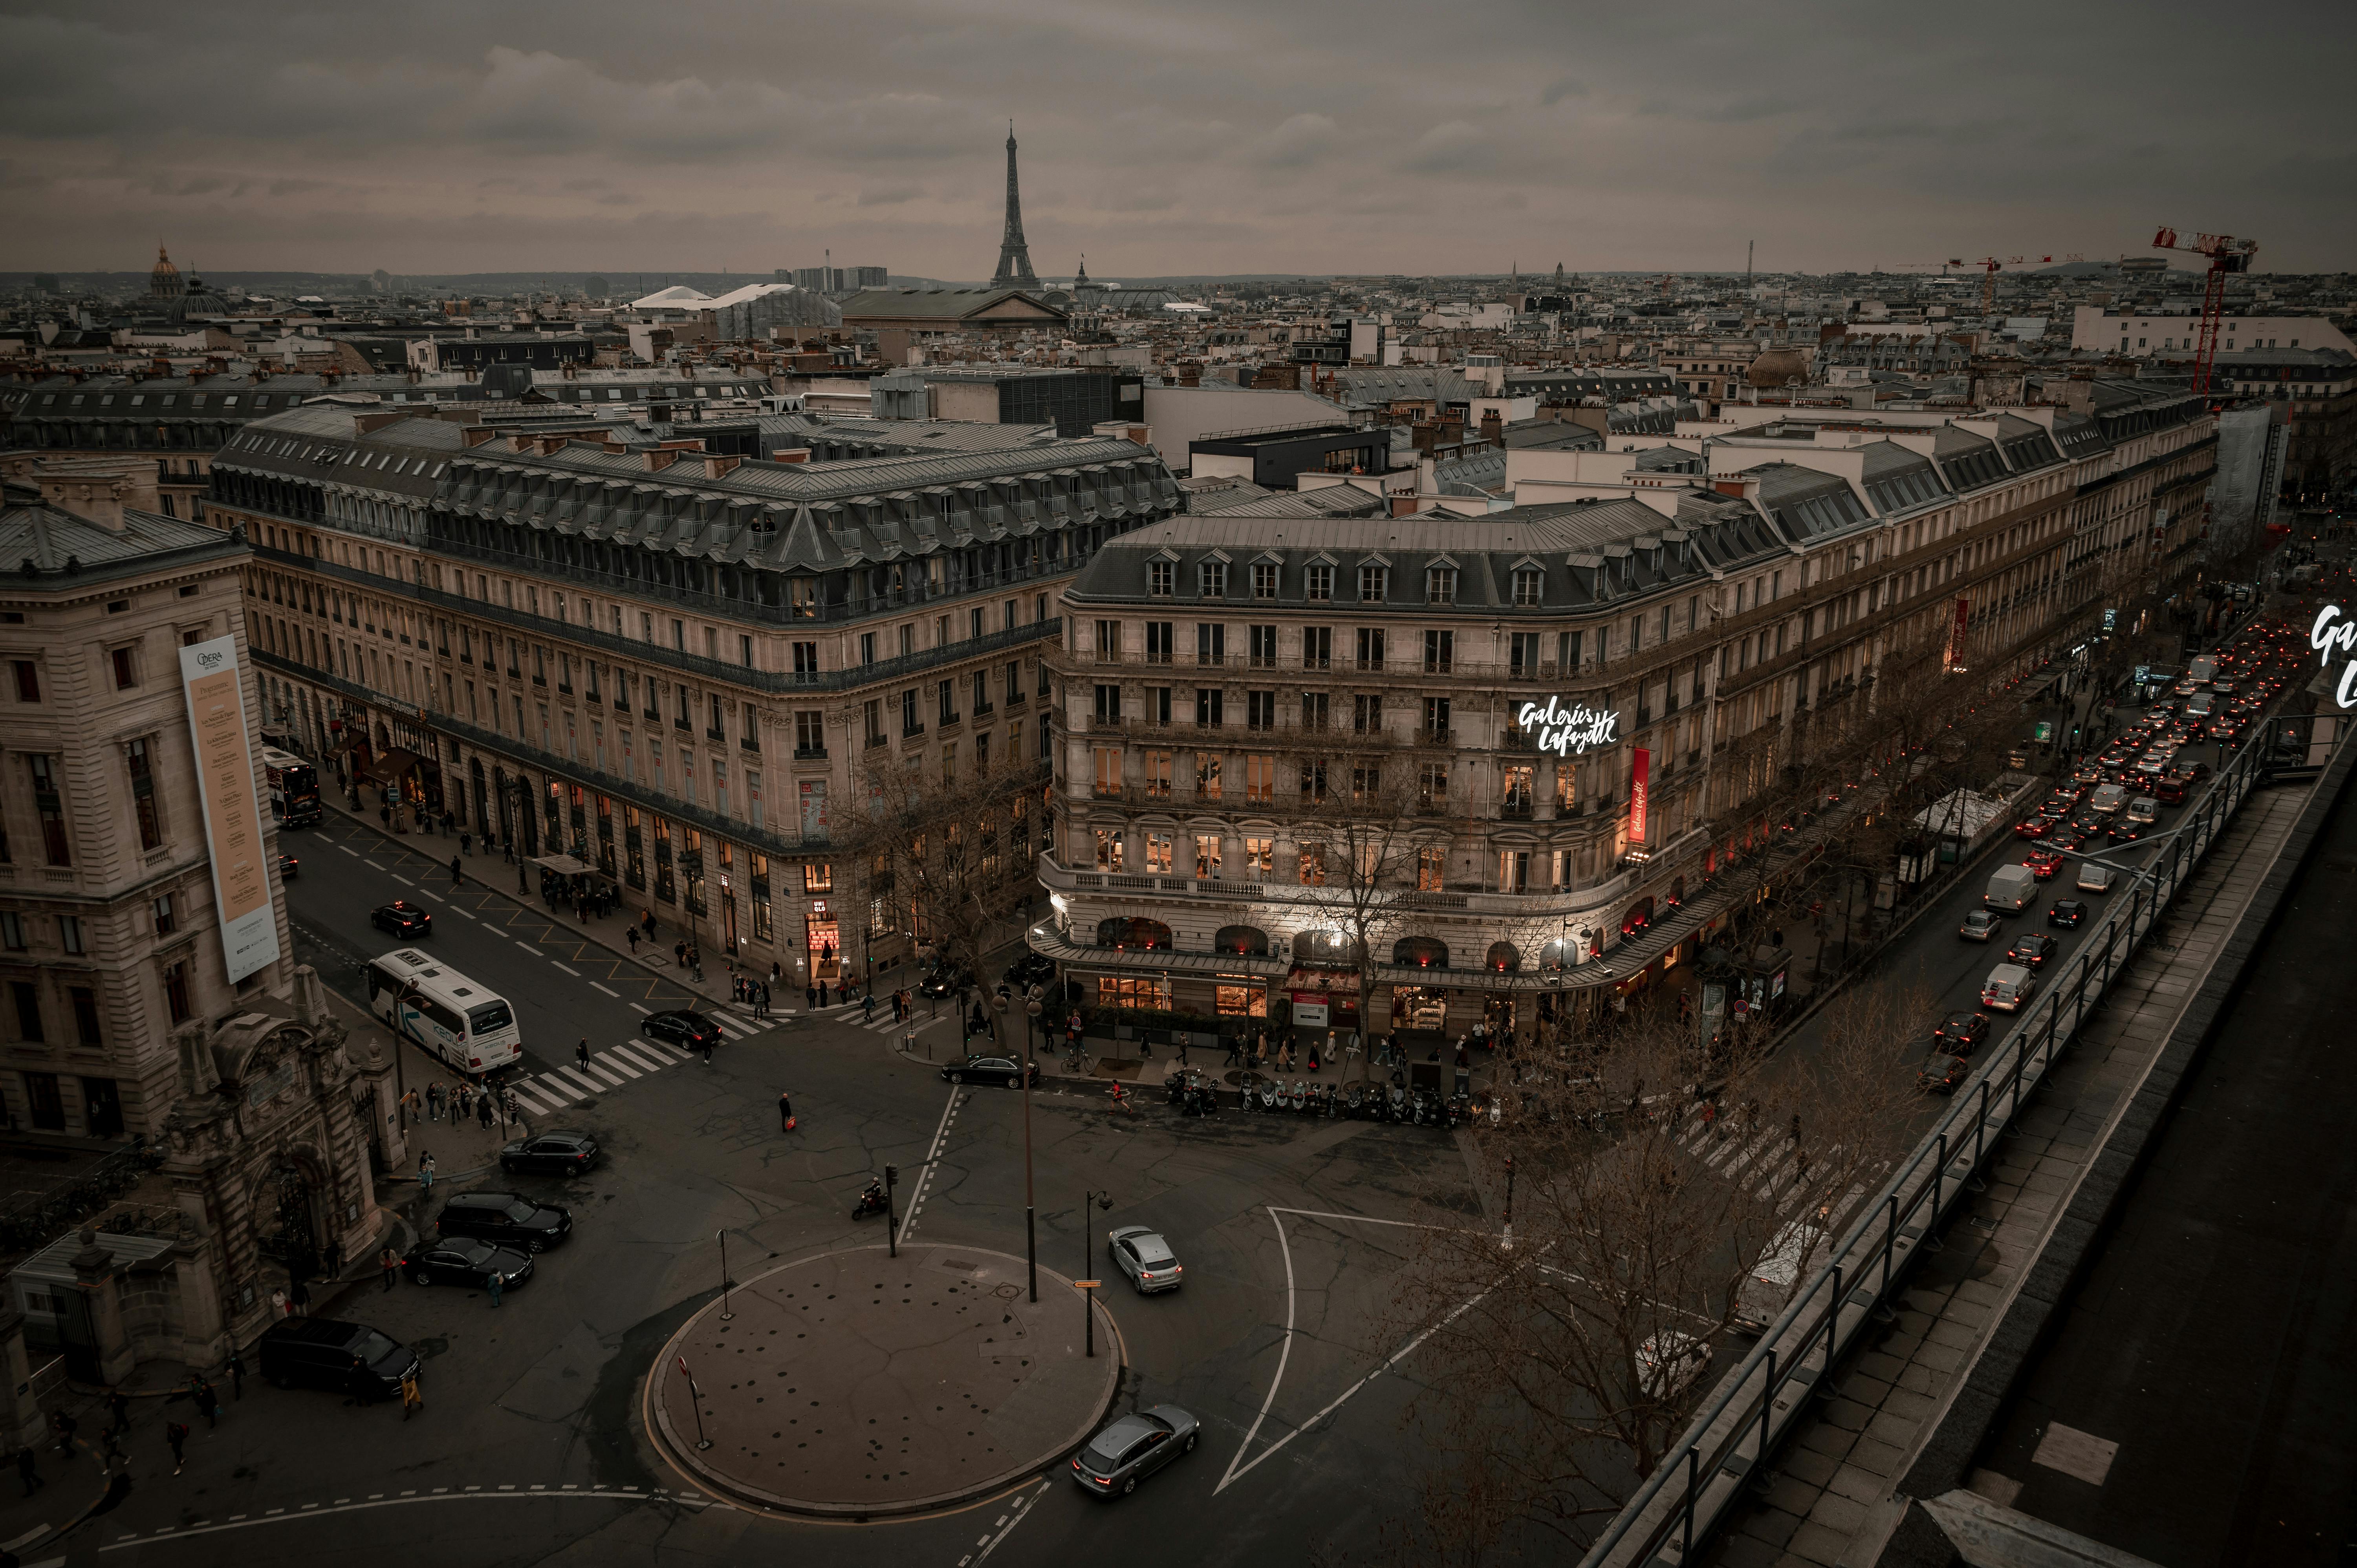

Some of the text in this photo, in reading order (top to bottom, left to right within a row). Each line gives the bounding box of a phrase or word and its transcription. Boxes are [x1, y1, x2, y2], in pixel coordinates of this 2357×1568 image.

[198, 652, 223, 666] OPÉRA
[200, 681, 229, 694] Programme
[373, 695, 418, 717] SUISSE TOURISME
[1519, 695, 1593, 733] Galeries
[1538, 710, 1619, 757] Lafayette
[221, 751, 237, 761] Giovanni
[1634, 779, 1644, 809] Lafayette
[1632, 809, 1643, 832] Galeries
[1568, 892, 1606, 906] LAFAYETTE
